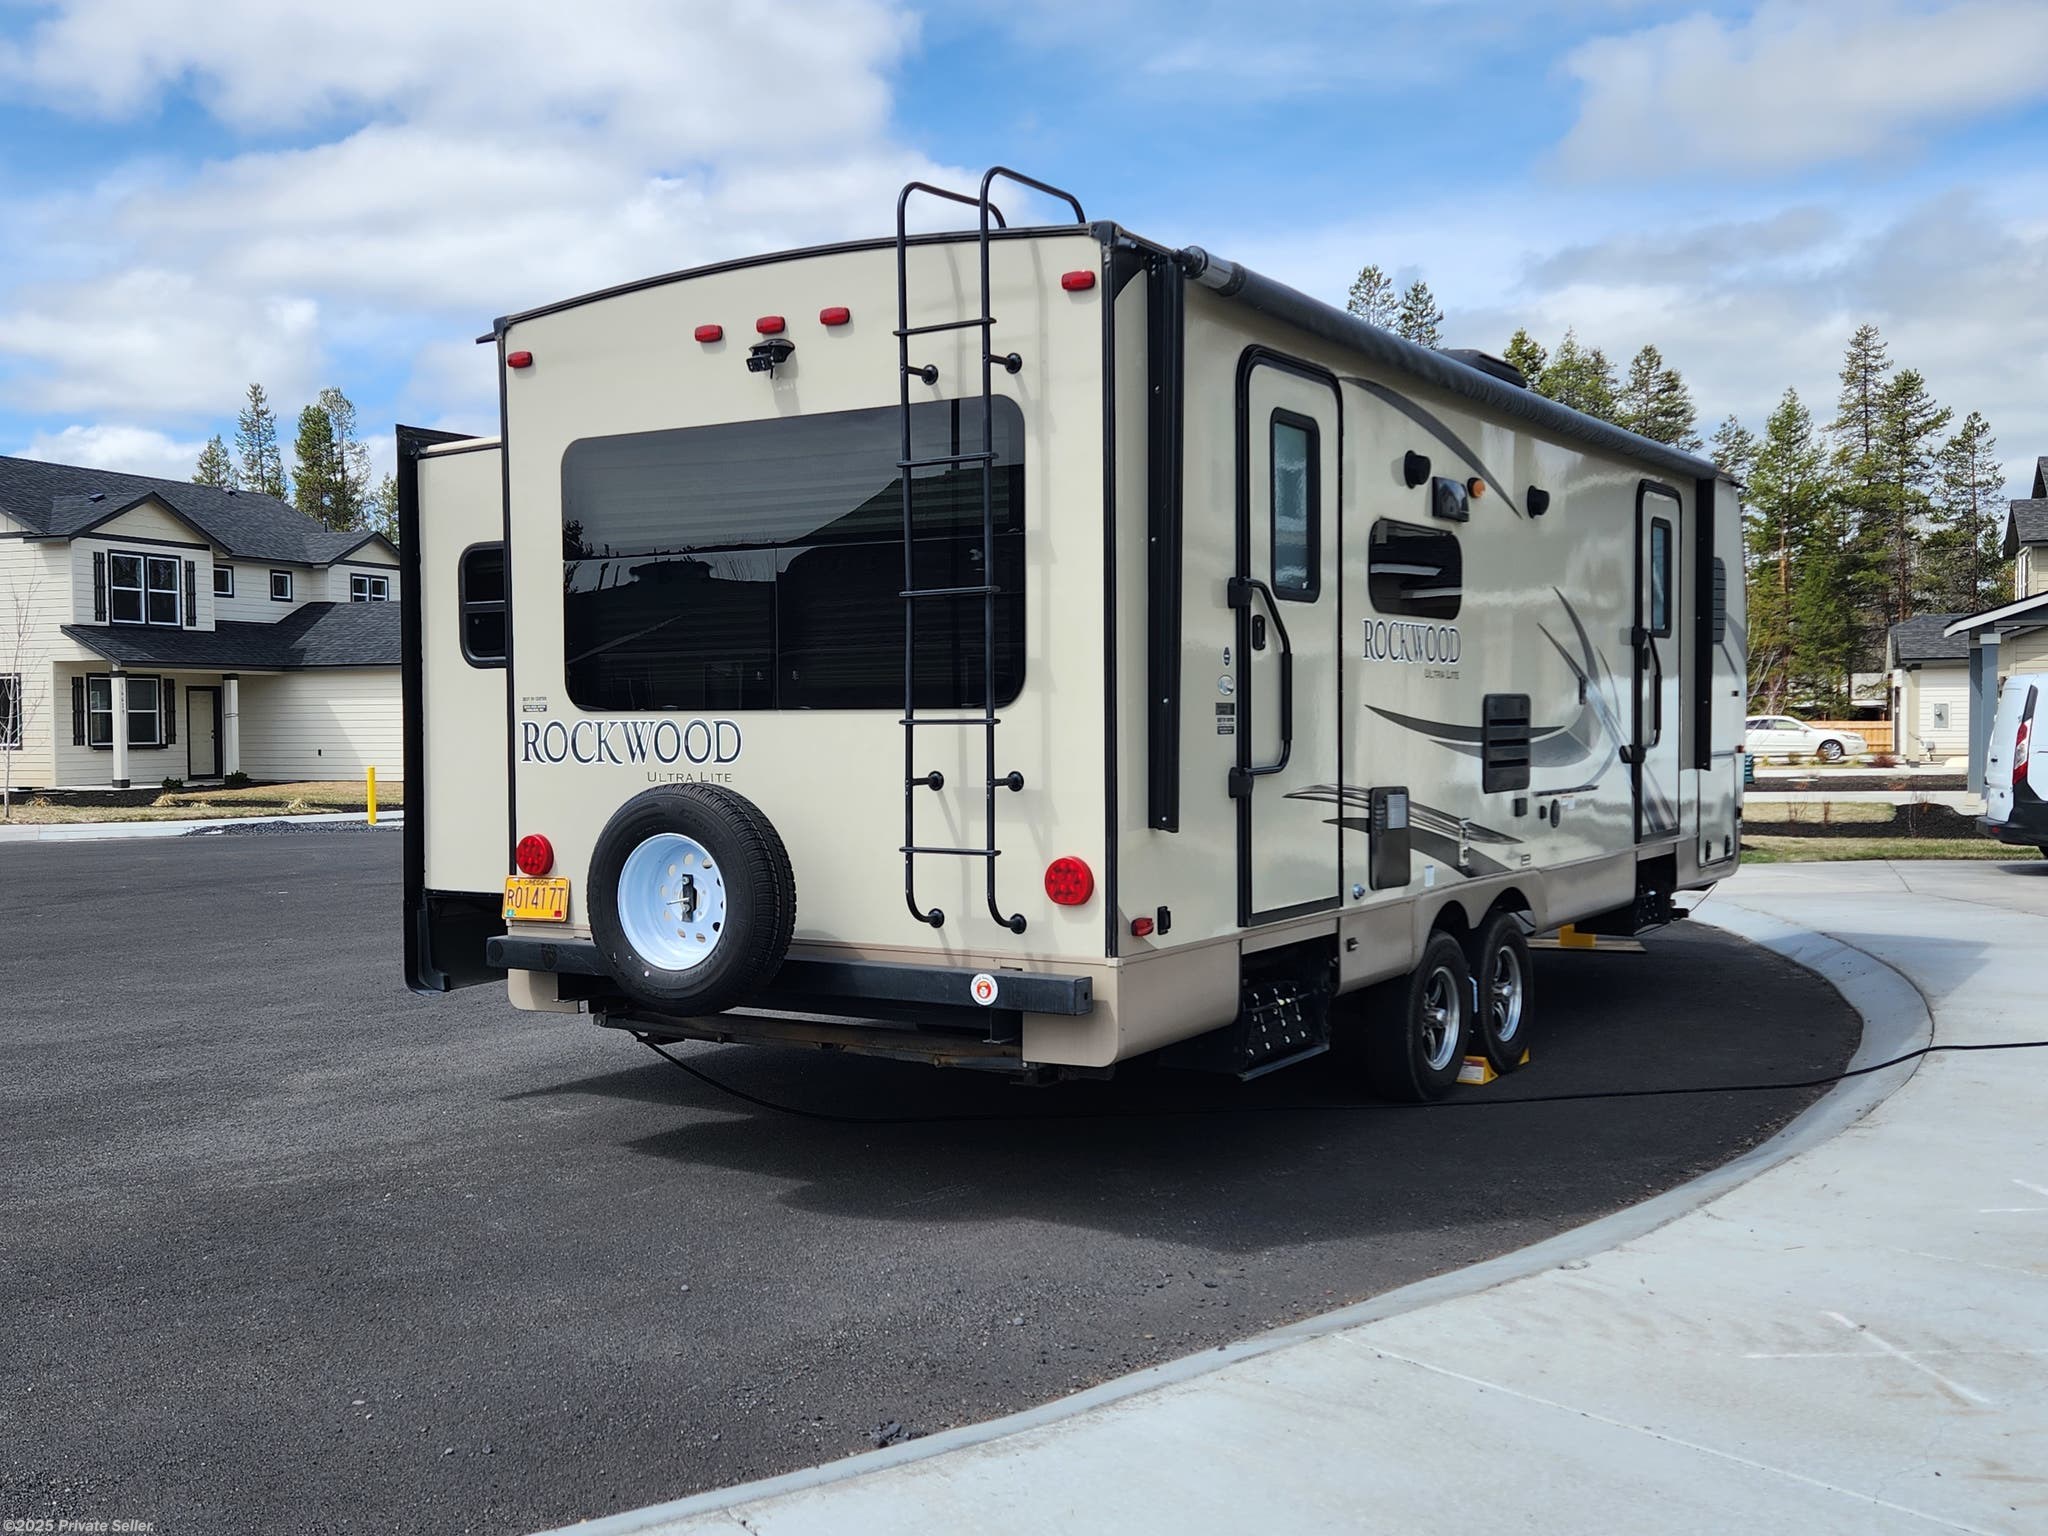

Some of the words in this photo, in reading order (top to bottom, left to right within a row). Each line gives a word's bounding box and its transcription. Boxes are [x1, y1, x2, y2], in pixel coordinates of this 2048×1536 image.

[1362, 619, 1462, 663] ROCKWOOD
[520, 718, 743, 766] ROCKWOOD
[647, 771, 694, 783] ULTRA
[700, 771, 733, 783] LITE
